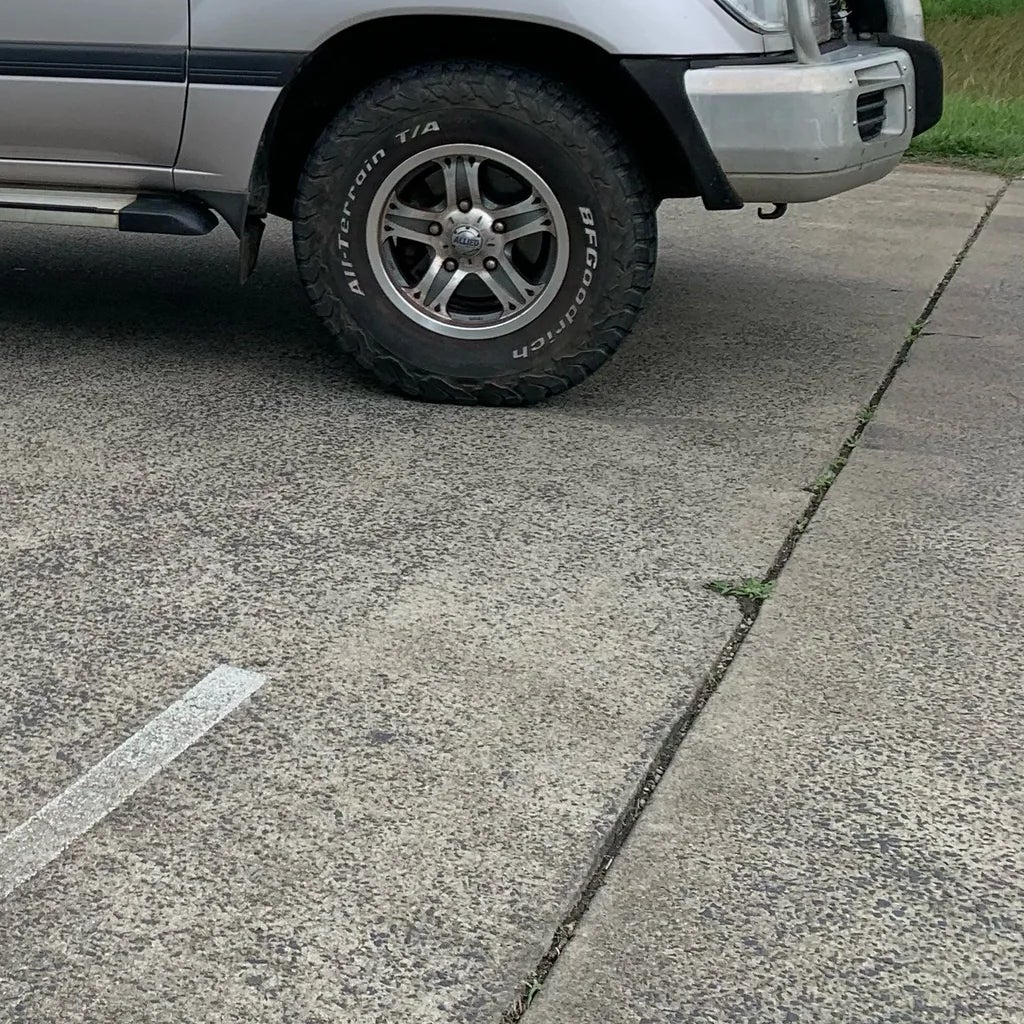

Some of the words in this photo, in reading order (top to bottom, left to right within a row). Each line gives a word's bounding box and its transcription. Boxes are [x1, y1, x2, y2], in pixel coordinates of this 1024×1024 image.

[339, 147, 387, 297] All-Terrain
[395, 119, 441, 144] T/A
[511, 205, 599, 361] BFGoodrich
